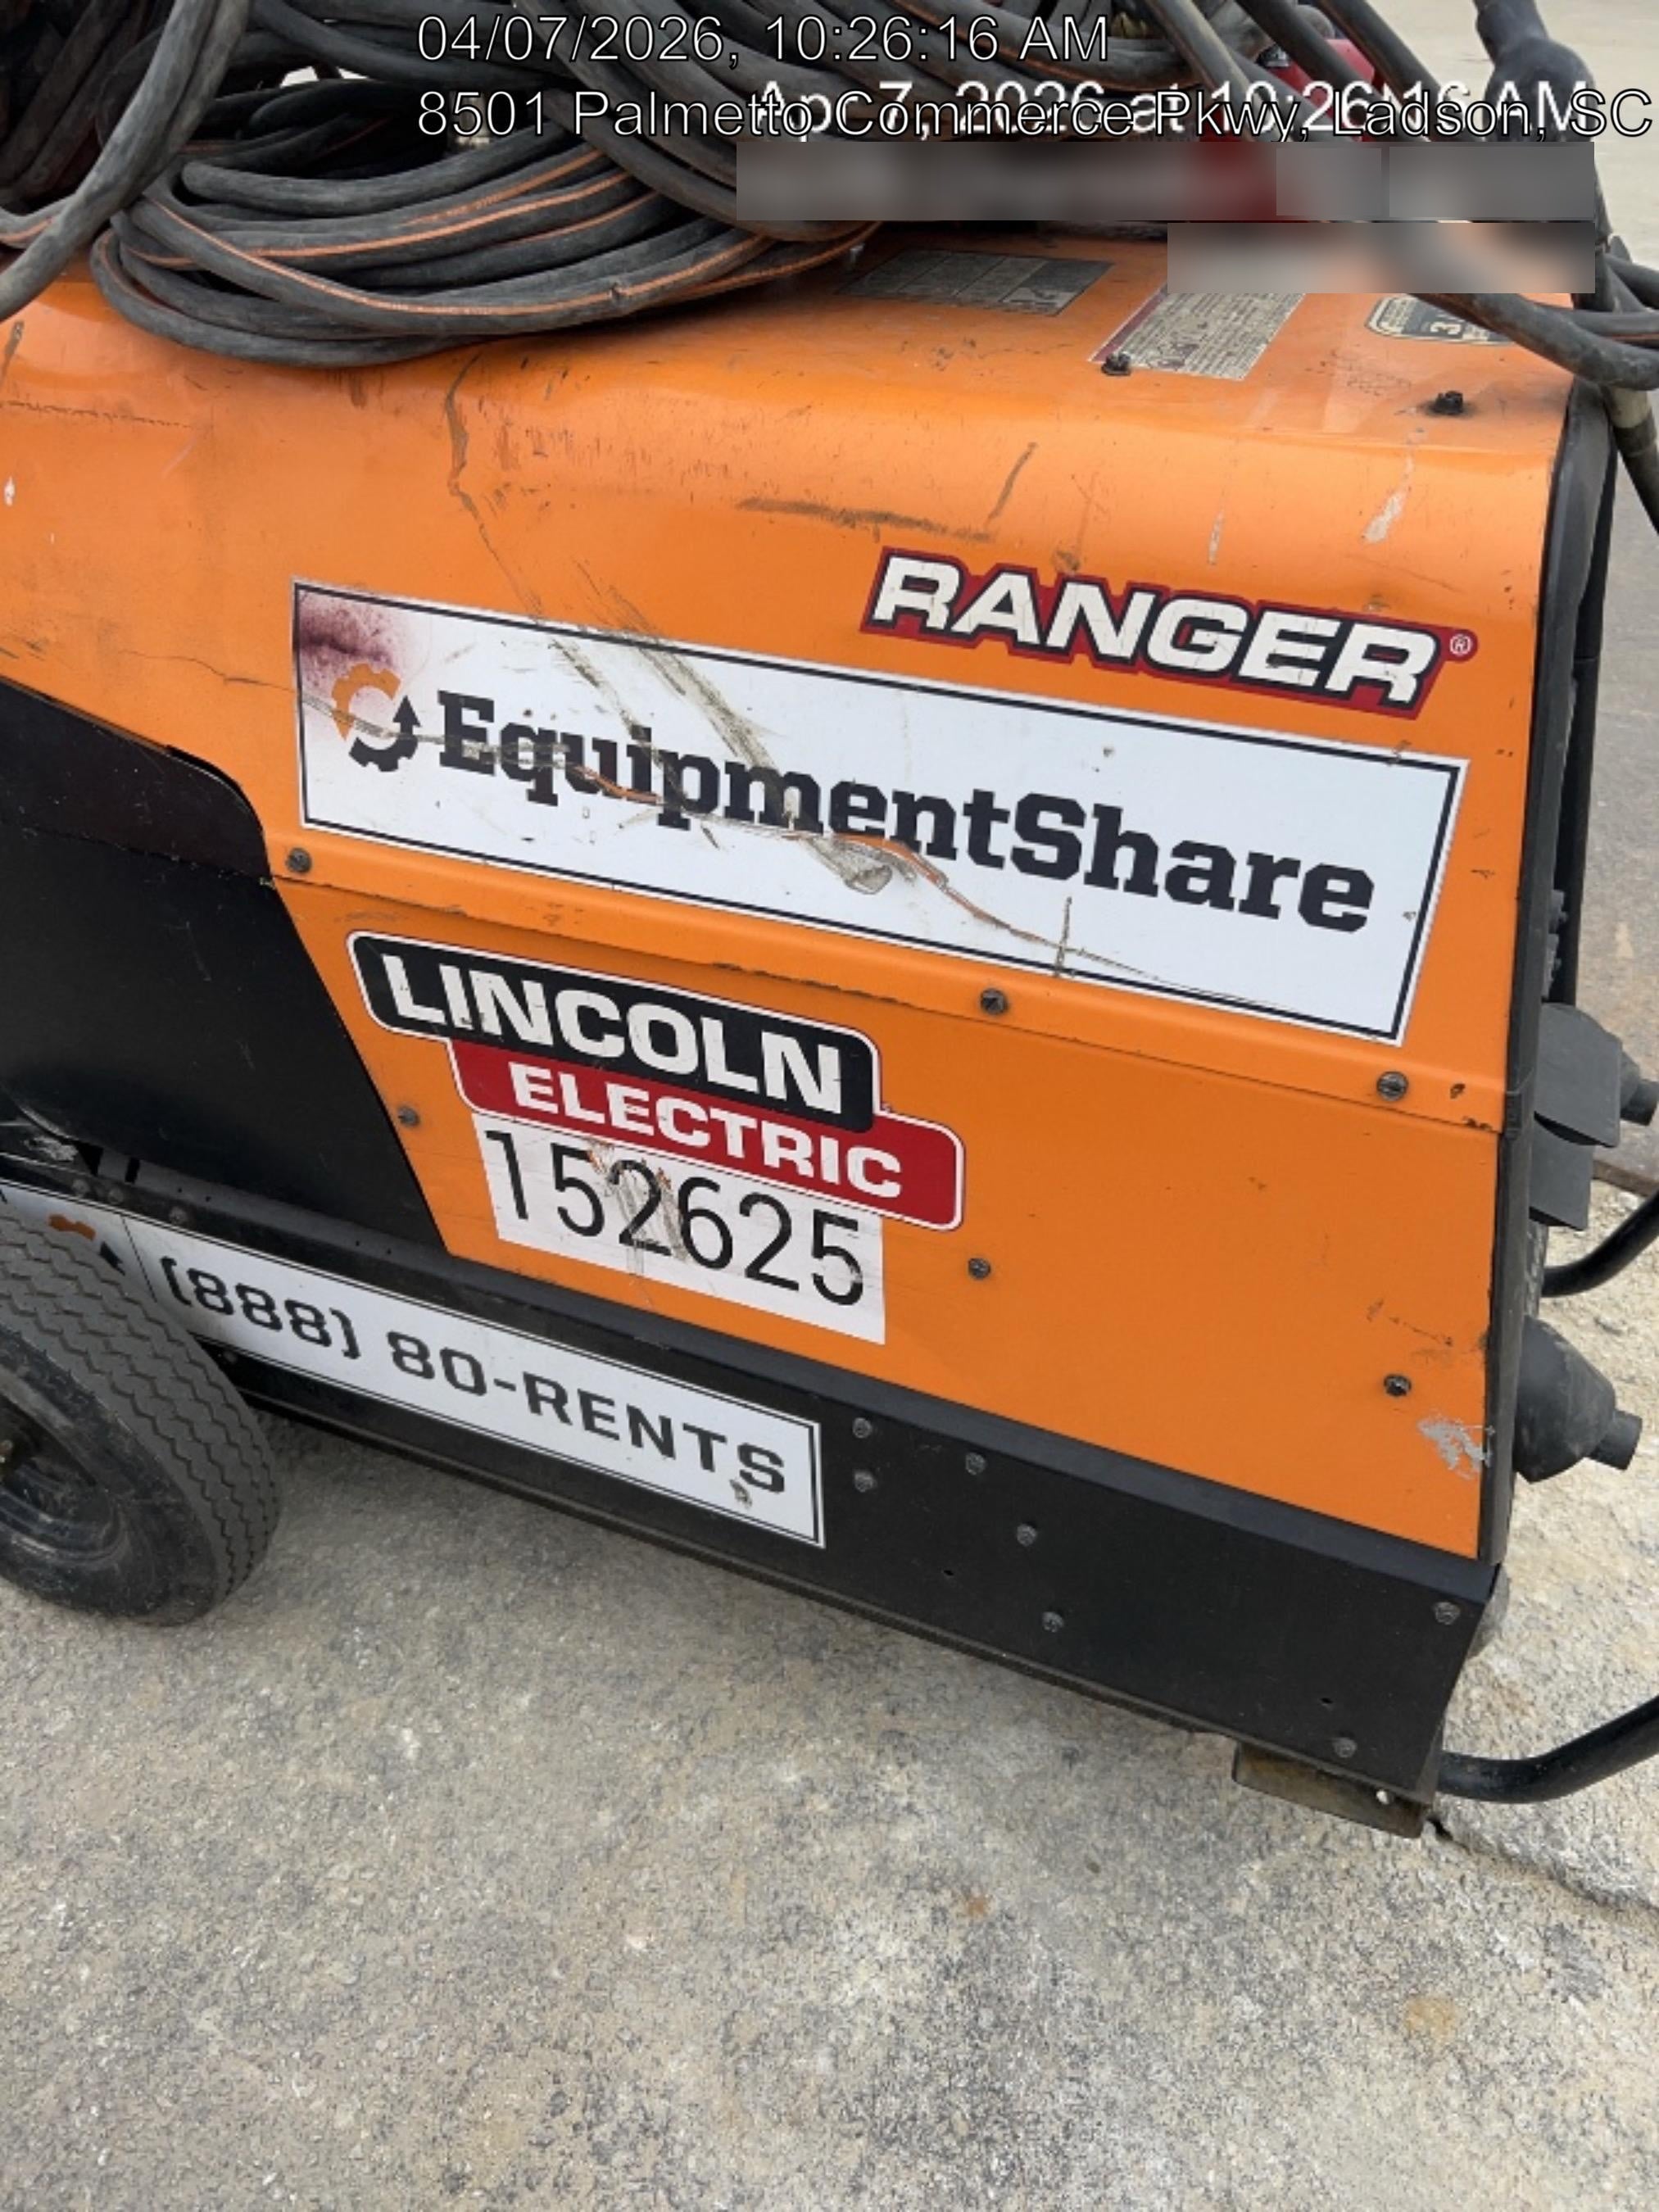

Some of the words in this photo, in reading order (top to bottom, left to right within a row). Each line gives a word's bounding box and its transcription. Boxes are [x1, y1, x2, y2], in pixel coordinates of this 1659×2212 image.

[436, 690, 1375, 933] EquipmentShare
[382, 954, 842, 1114] LINCOLN
[484, 1130, 865, 1307] 152625
[507, 1062, 904, 1199] ELECTRIC
[160, 1255, 361, 1360] (888)
[388, 1330, 786, 1494] 80-RENTS
